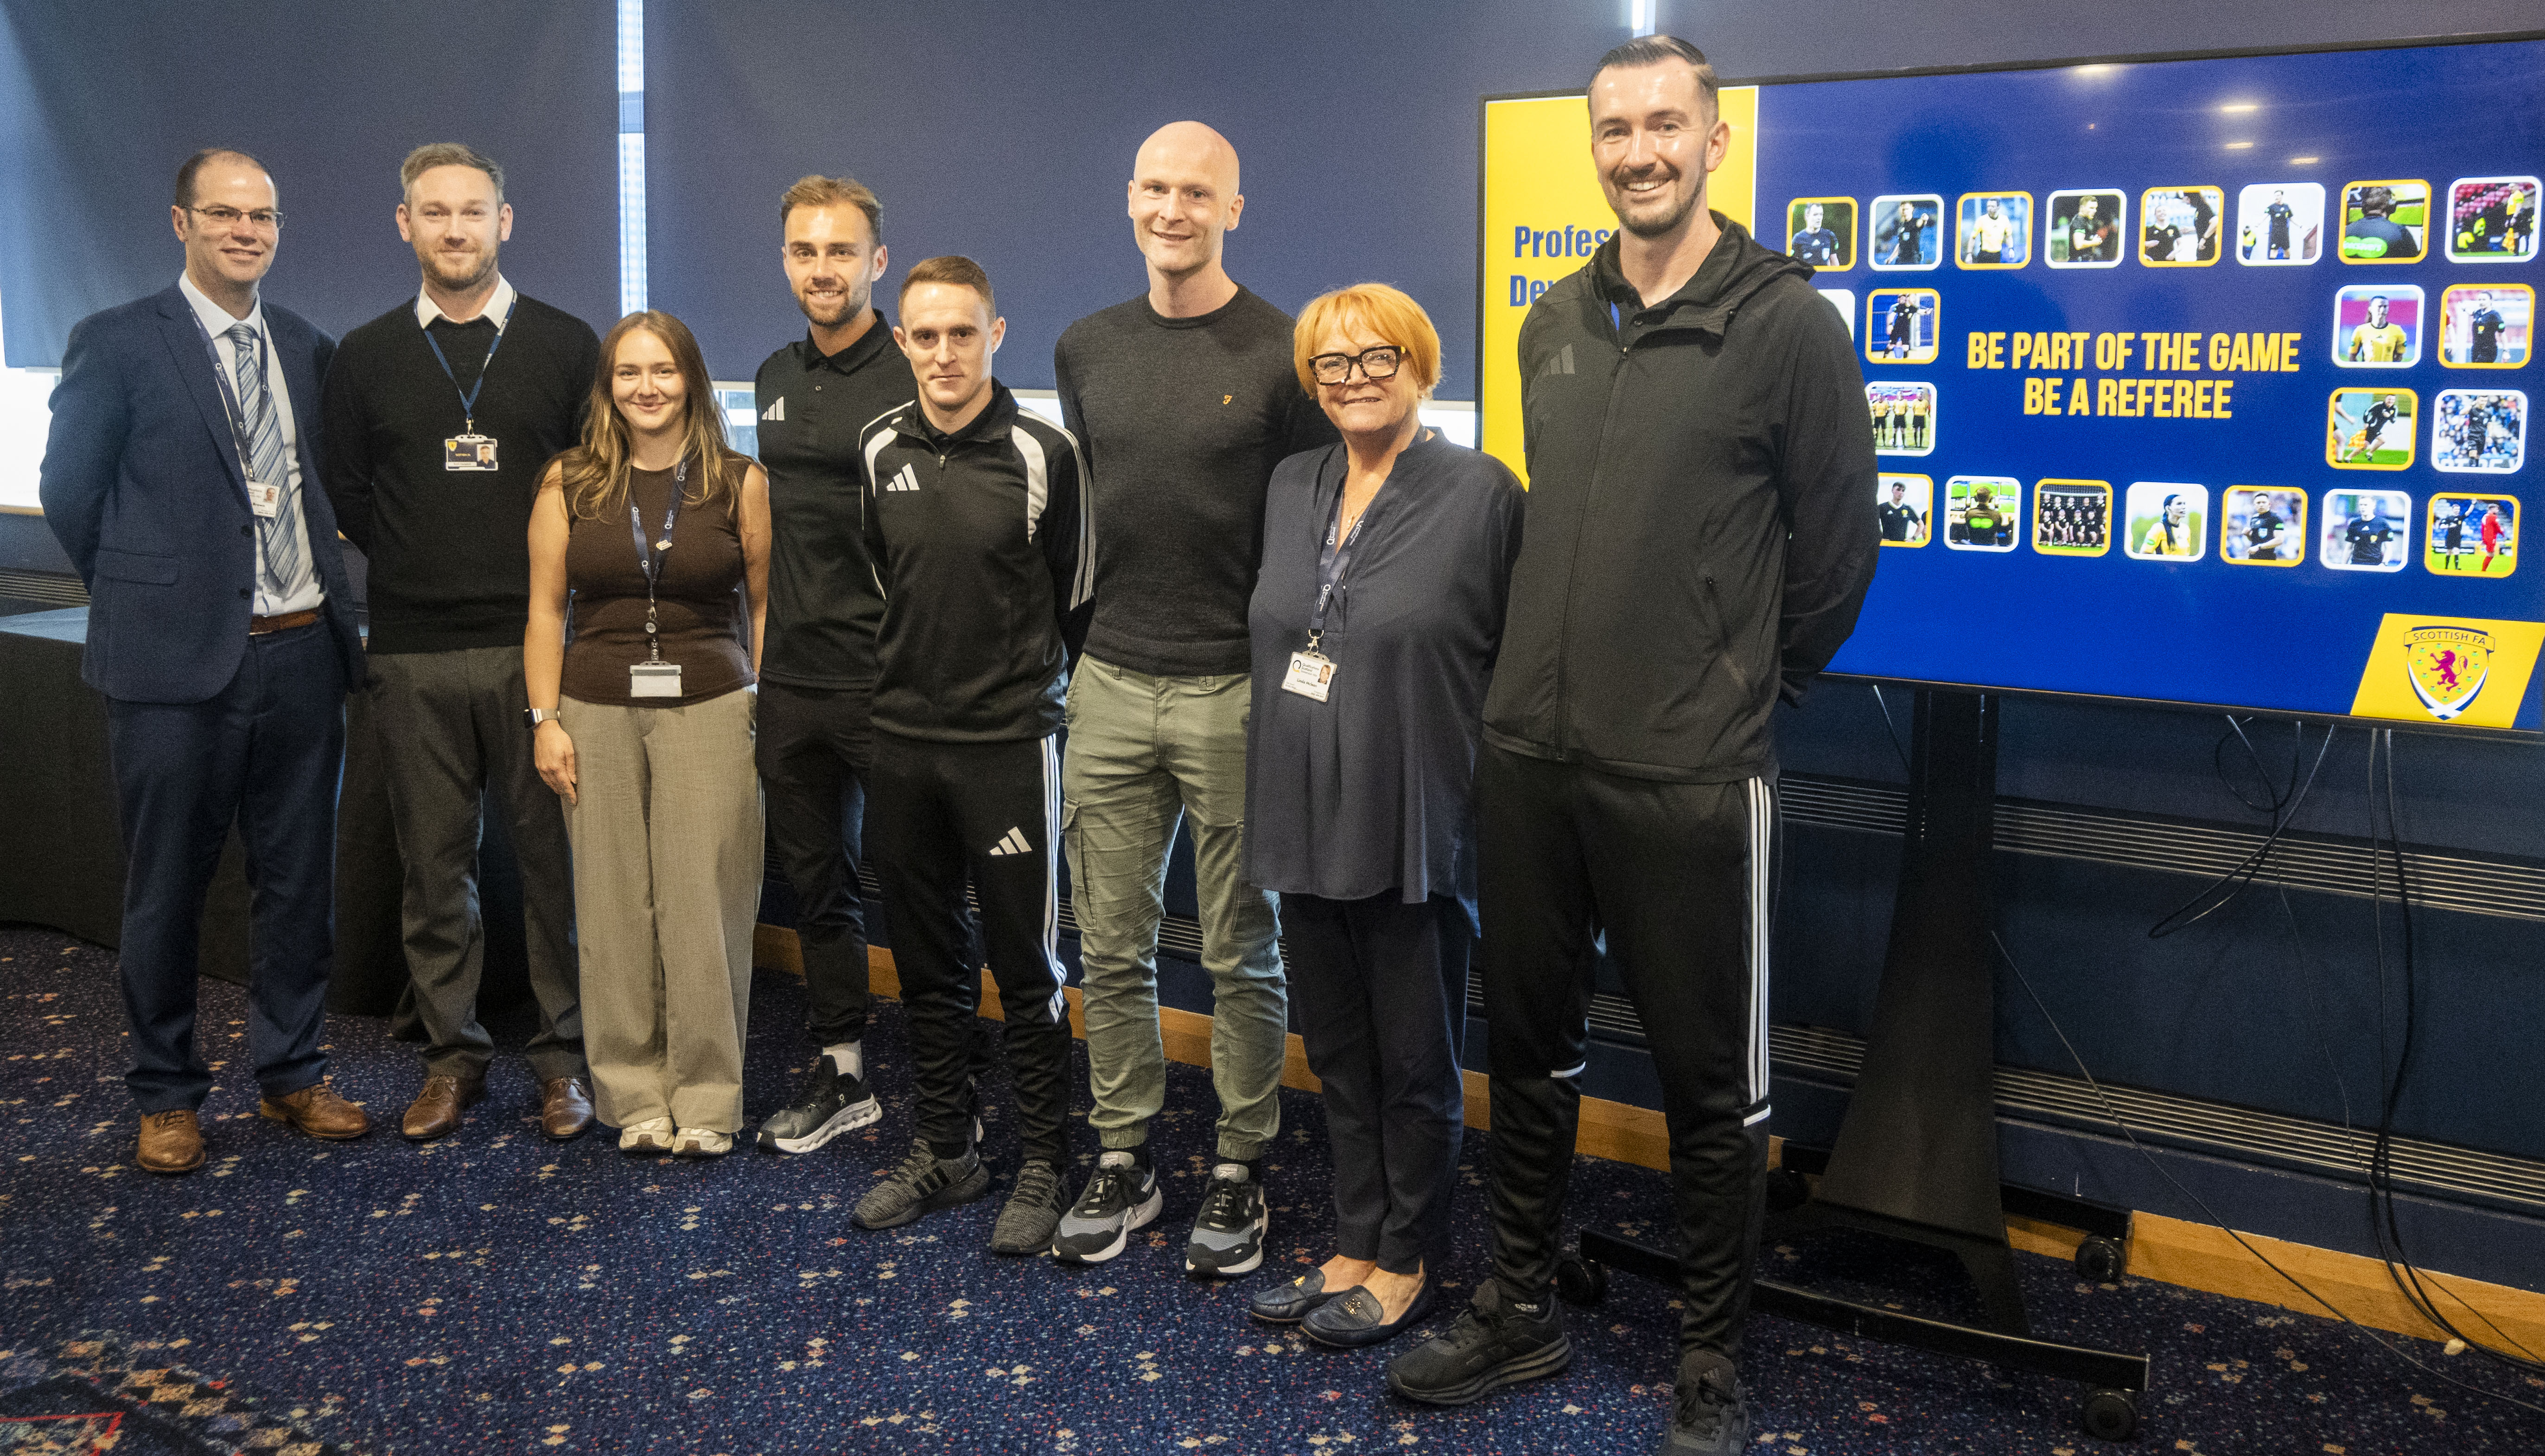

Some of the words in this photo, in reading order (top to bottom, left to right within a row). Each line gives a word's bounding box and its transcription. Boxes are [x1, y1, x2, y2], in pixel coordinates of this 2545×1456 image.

[1514, 224, 1618, 257] Profes
[1968, 332, 2005, 369] BE
[2012, 332, 2090, 369] PART
[2095, 332, 2135, 370] OF
[2141, 332, 2202, 370] THE
[2209, 332, 2301, 372] GAME
[2024, 378, 2062, 415] BE
[2068, 378, 2090, 415] A
[2097, 379, 2233, 419] REFEREE
[2413, 631, 2469, 641] SCOTTISH
[2473, 636, 2485, 645] FA
